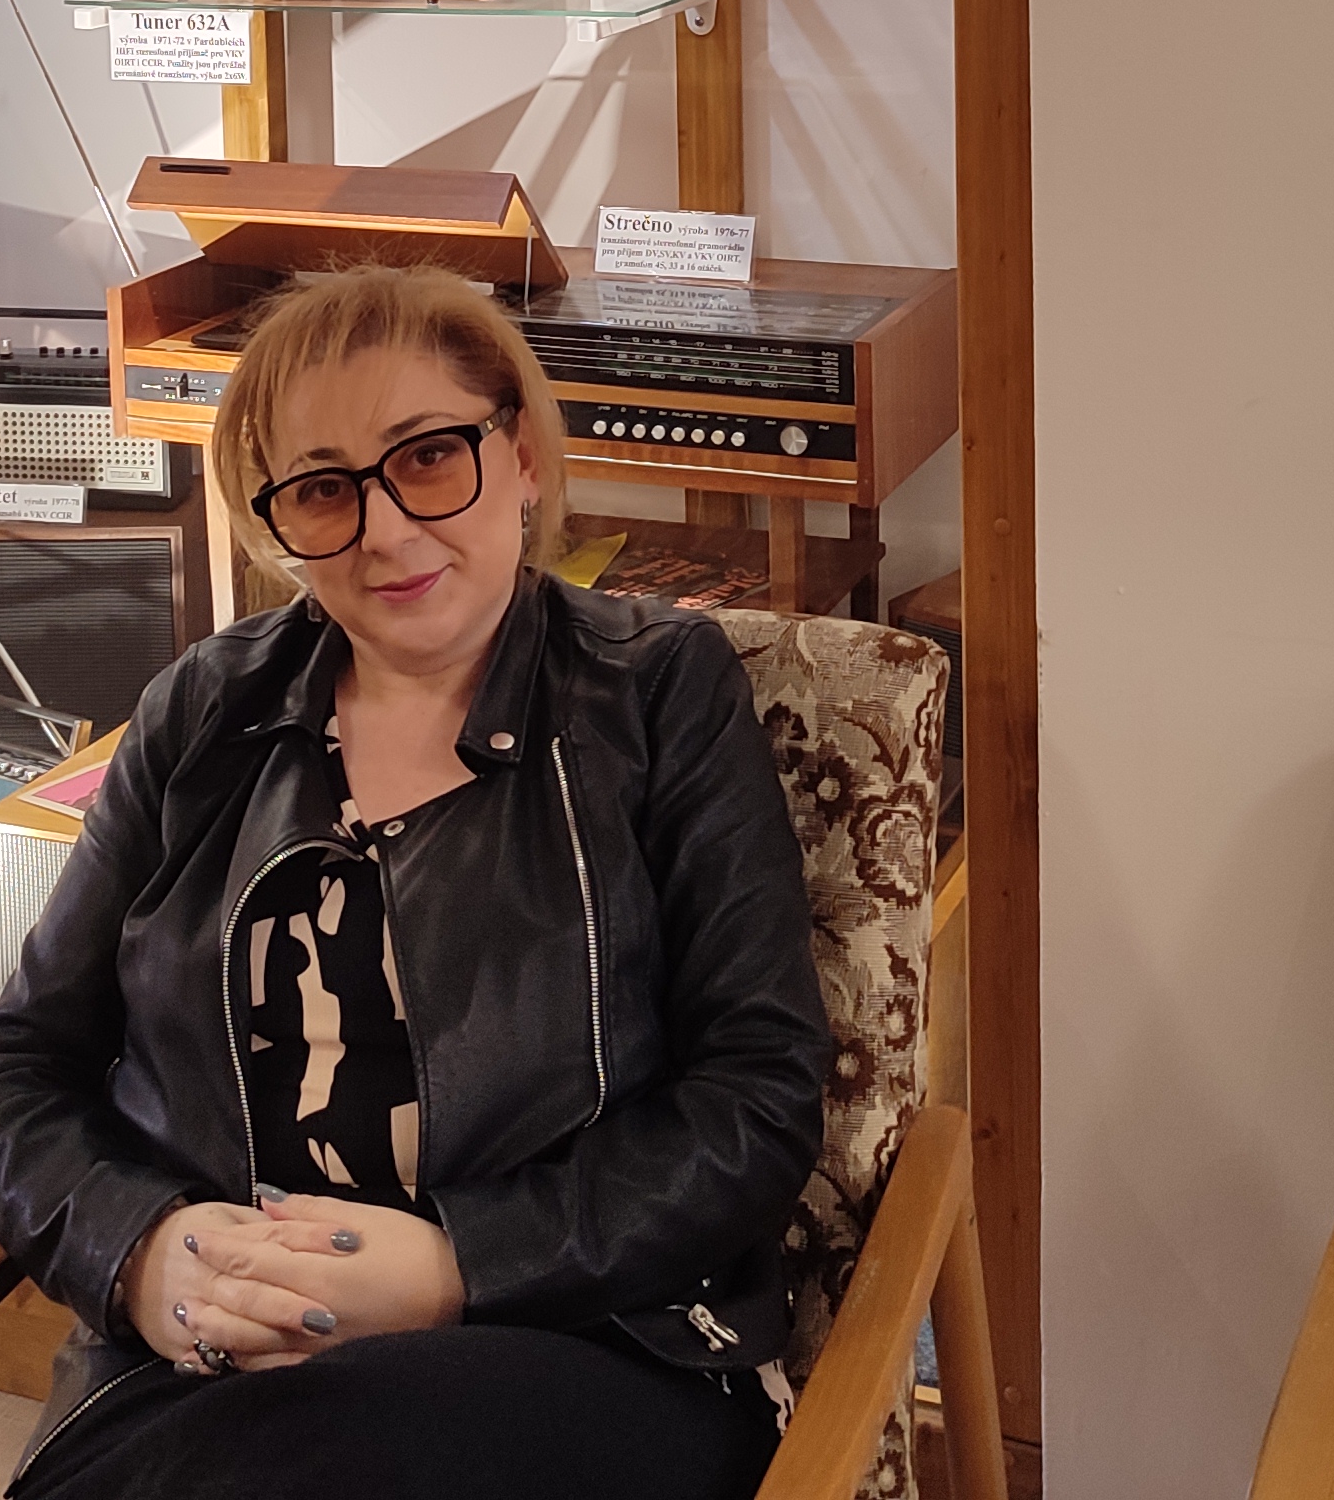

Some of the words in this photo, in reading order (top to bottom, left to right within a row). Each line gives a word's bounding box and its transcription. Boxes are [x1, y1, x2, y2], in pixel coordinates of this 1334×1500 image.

[132, 13, 182, 30] Tuner
[187, 13, 230, 31] 632A
[119, 35, 148, 46] výroba
[153, 36, 185, 45] 1971-72
[194, 37, 245, 46] Pardubicích
[211, 50, 223, 58] pro
[196, 61, 210, 69] jsou
[605, 213, 673, 233] Strečno
[678, 225, 708, 236] výroba
[714, 227, 749, 238] 1976-77
[617, 248, 643, 258] příjem
[694, 252, 715, 260] VKV
[50, 511, 73, 519] CCIR
